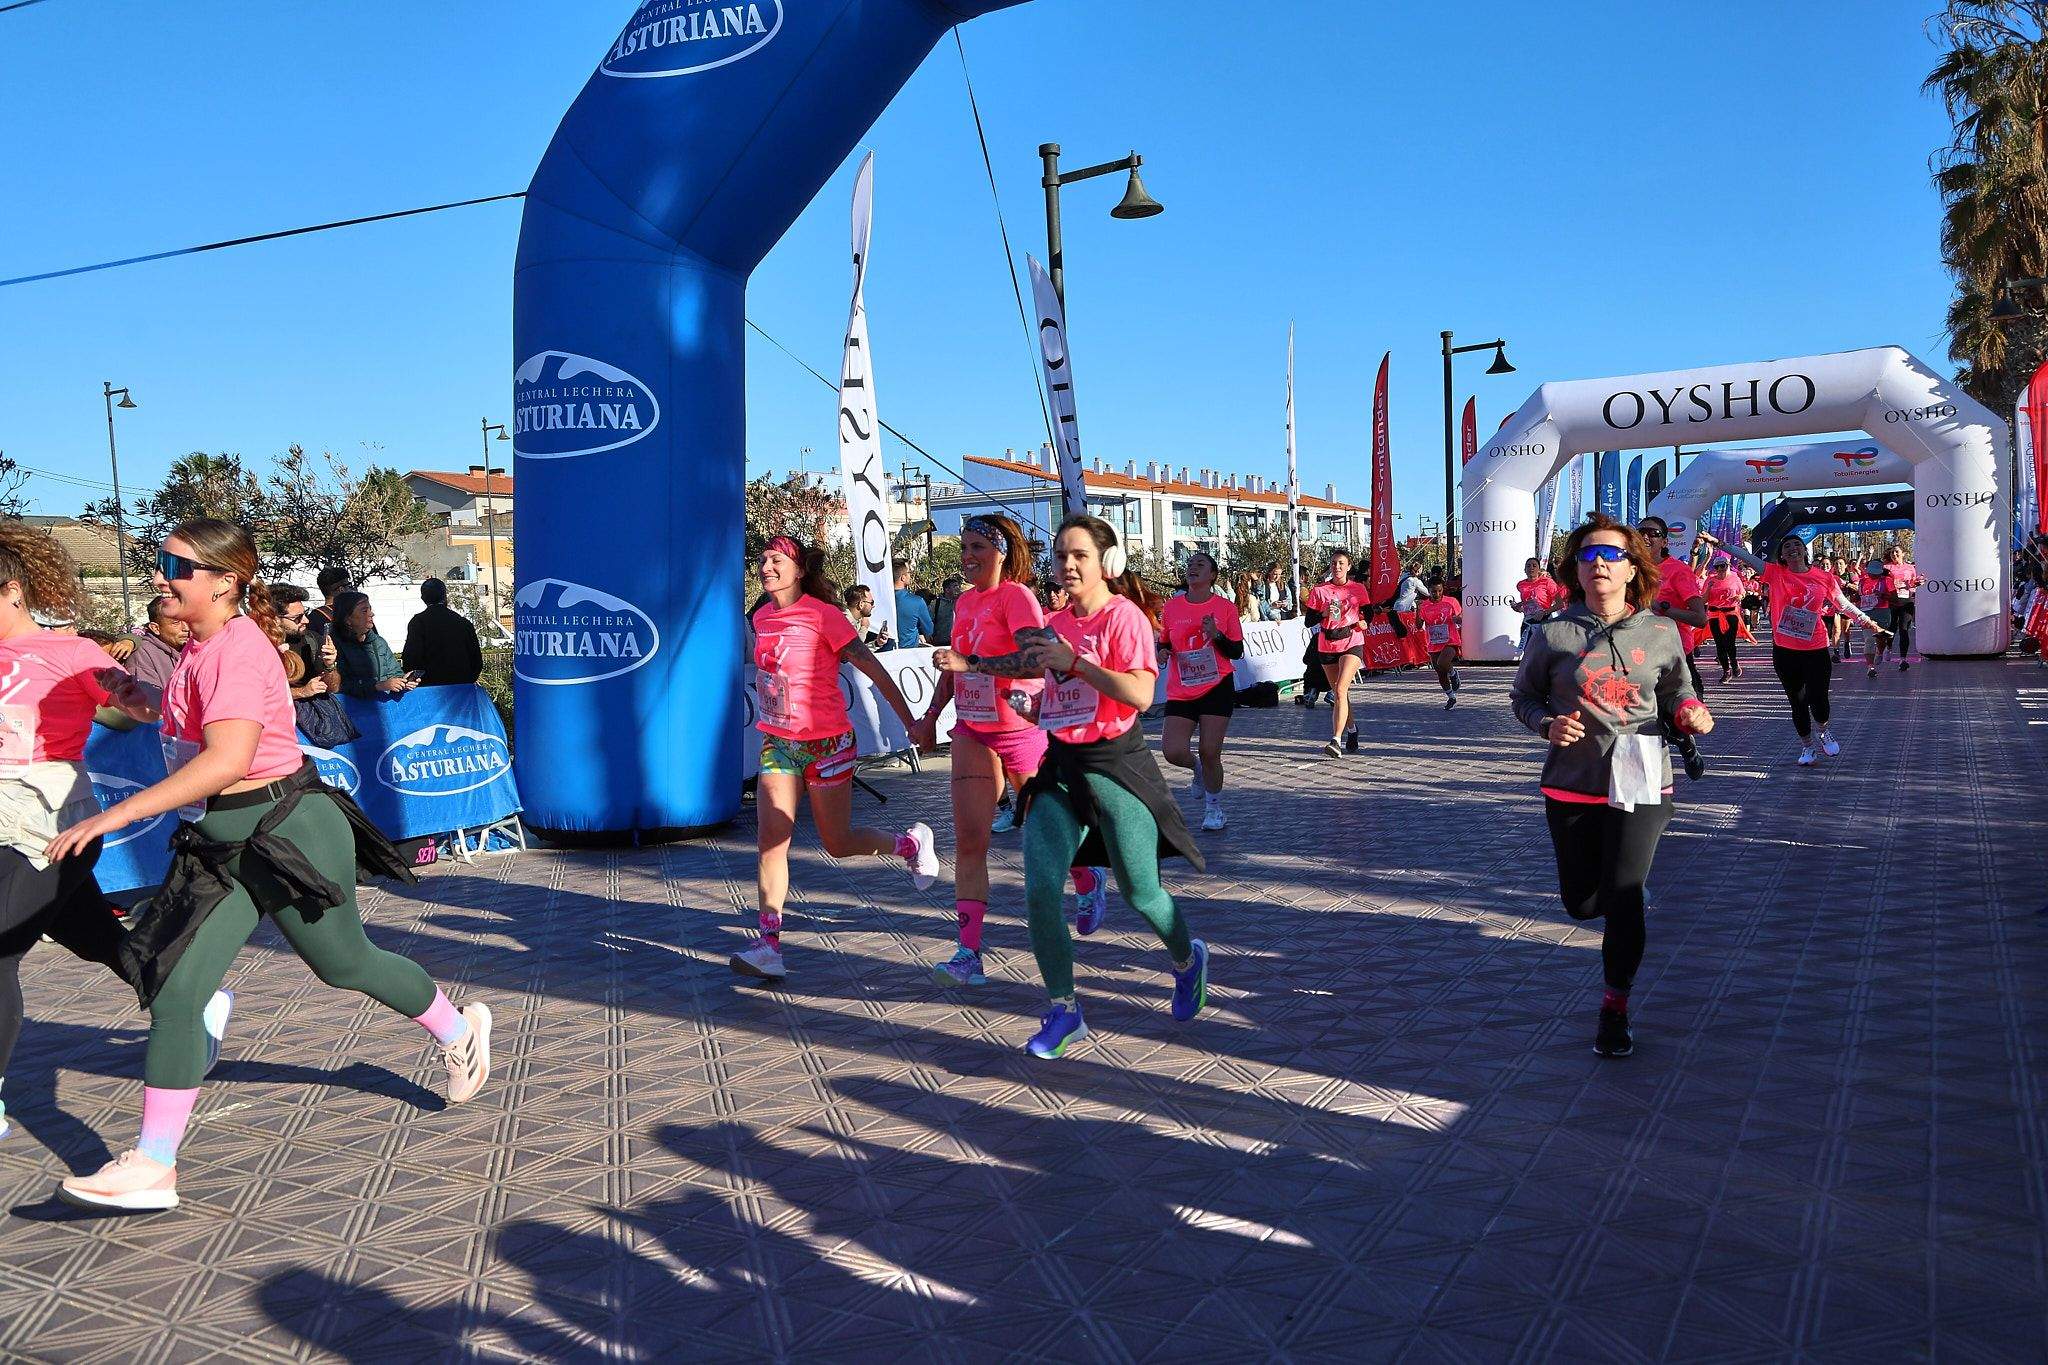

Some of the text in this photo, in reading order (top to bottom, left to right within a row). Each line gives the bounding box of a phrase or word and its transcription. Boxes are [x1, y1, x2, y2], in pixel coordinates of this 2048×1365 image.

[606, 3, 768, 65] ASTURIANA
[517, 387, 635, 403] CENTRAL LECHERA
[1602, 374, 1816, 430] OYSHO
[514, 402, 643, 435] STURIANA
[1884, 405, 1957, 424] OYSHO
[1489, 443, 1546, 458] OYSHO
[1833, 469, 1880, 478] TotalEnergies
[1804, 501, 1898, 515] VOLVO
[1926, 492, 1994, 508] OYSHO
[1466, 520, 1516, 533] OYSHO
[1928, 578, 1994, 593] OYSHO
[1466, 595, 1514, 607] OYSHO
[517, 615, 634, 626] CENTRAL LECHERA
[514, 631, 642, 657] STURIANA
[1241, 628, 1285, 659] YSHO
[964, 690, 980, 699] 016
[1058, 688, 1080, 702] 016
[407, 743, 495, 760] CENTRAL LECHERA
[391, 751, 506, 783] ASTURIANA
